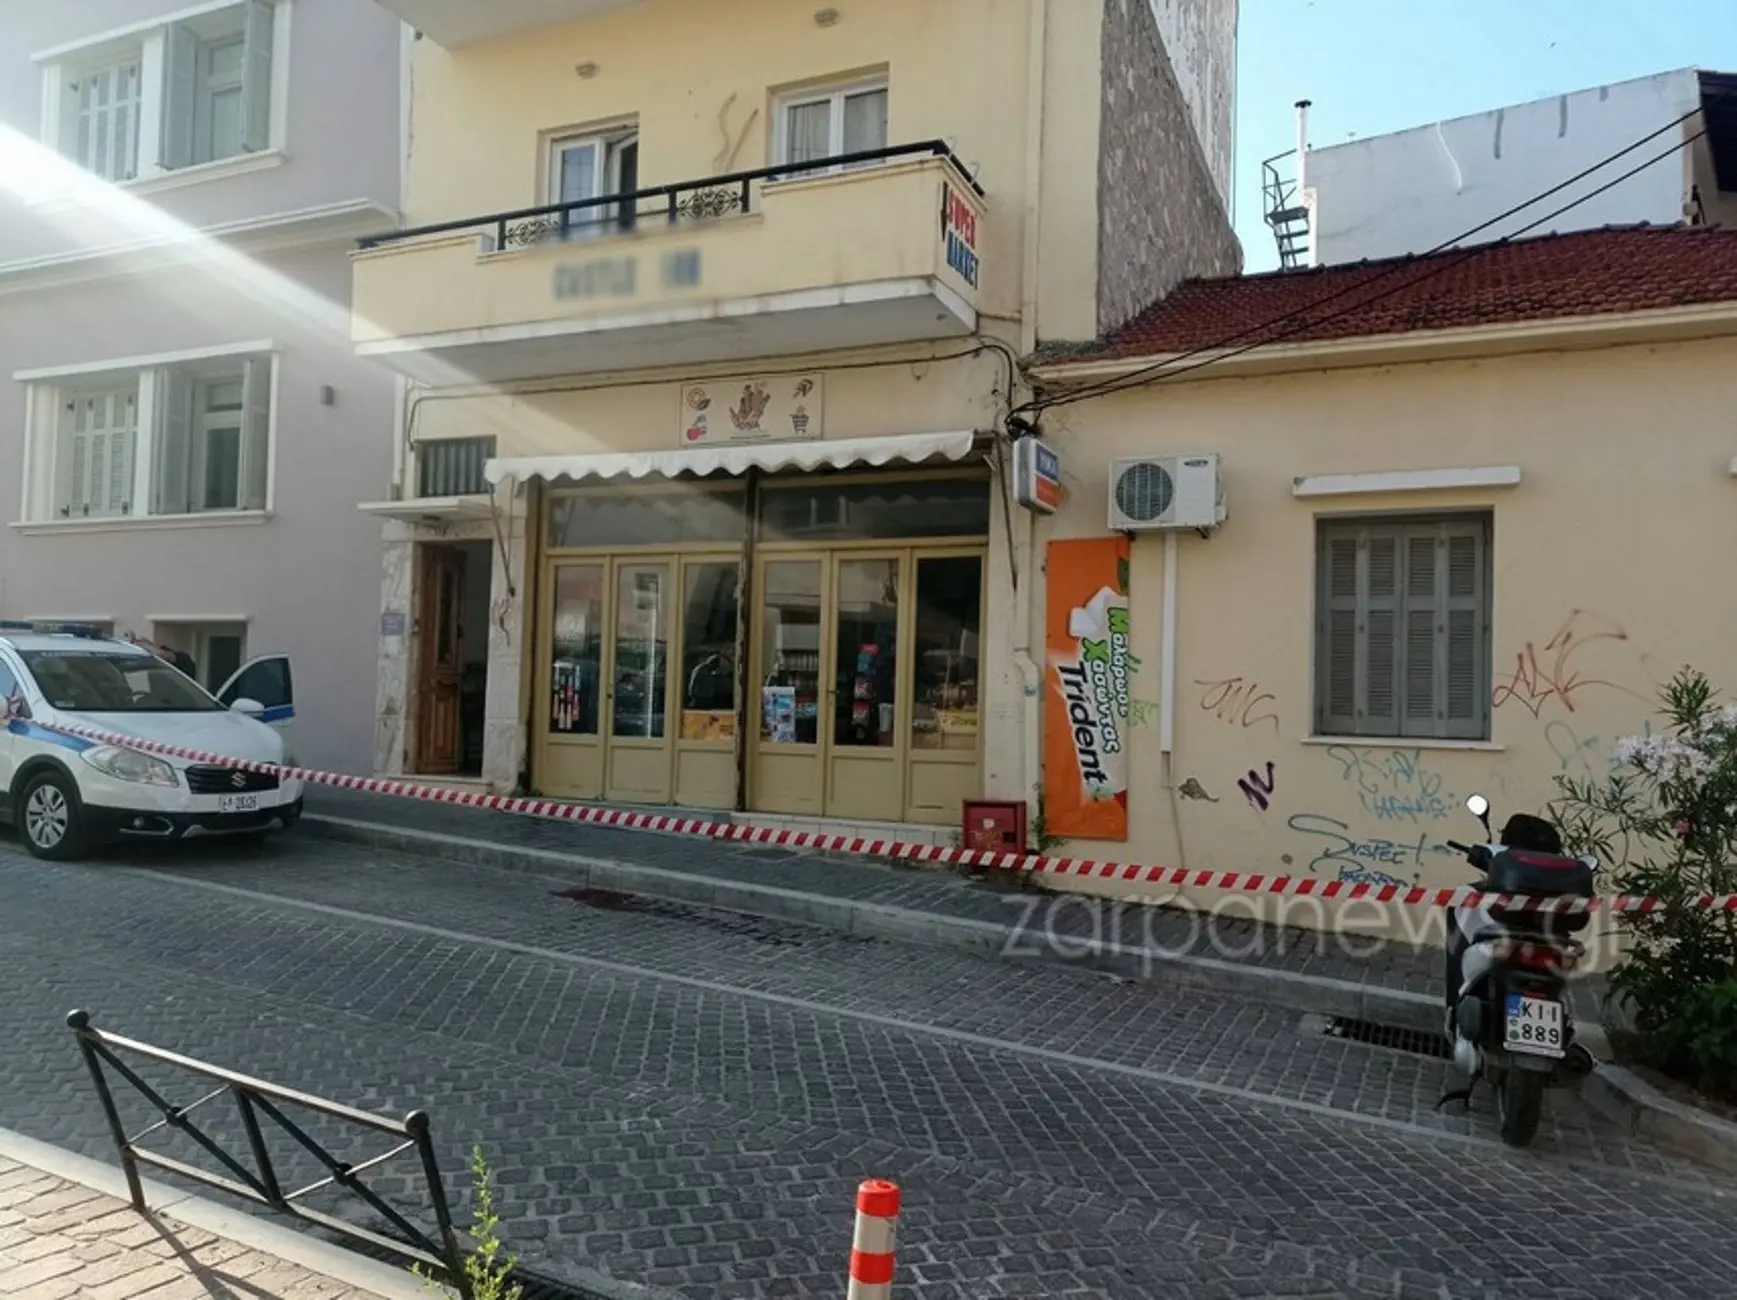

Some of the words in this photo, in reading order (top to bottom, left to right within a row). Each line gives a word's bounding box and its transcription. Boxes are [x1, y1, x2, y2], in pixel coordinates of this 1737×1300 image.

[947, 188, 976, 249] SUPER
[1058, 660, 1109, 785] Trident
[1522, 1023, 1559, 1045] 889
